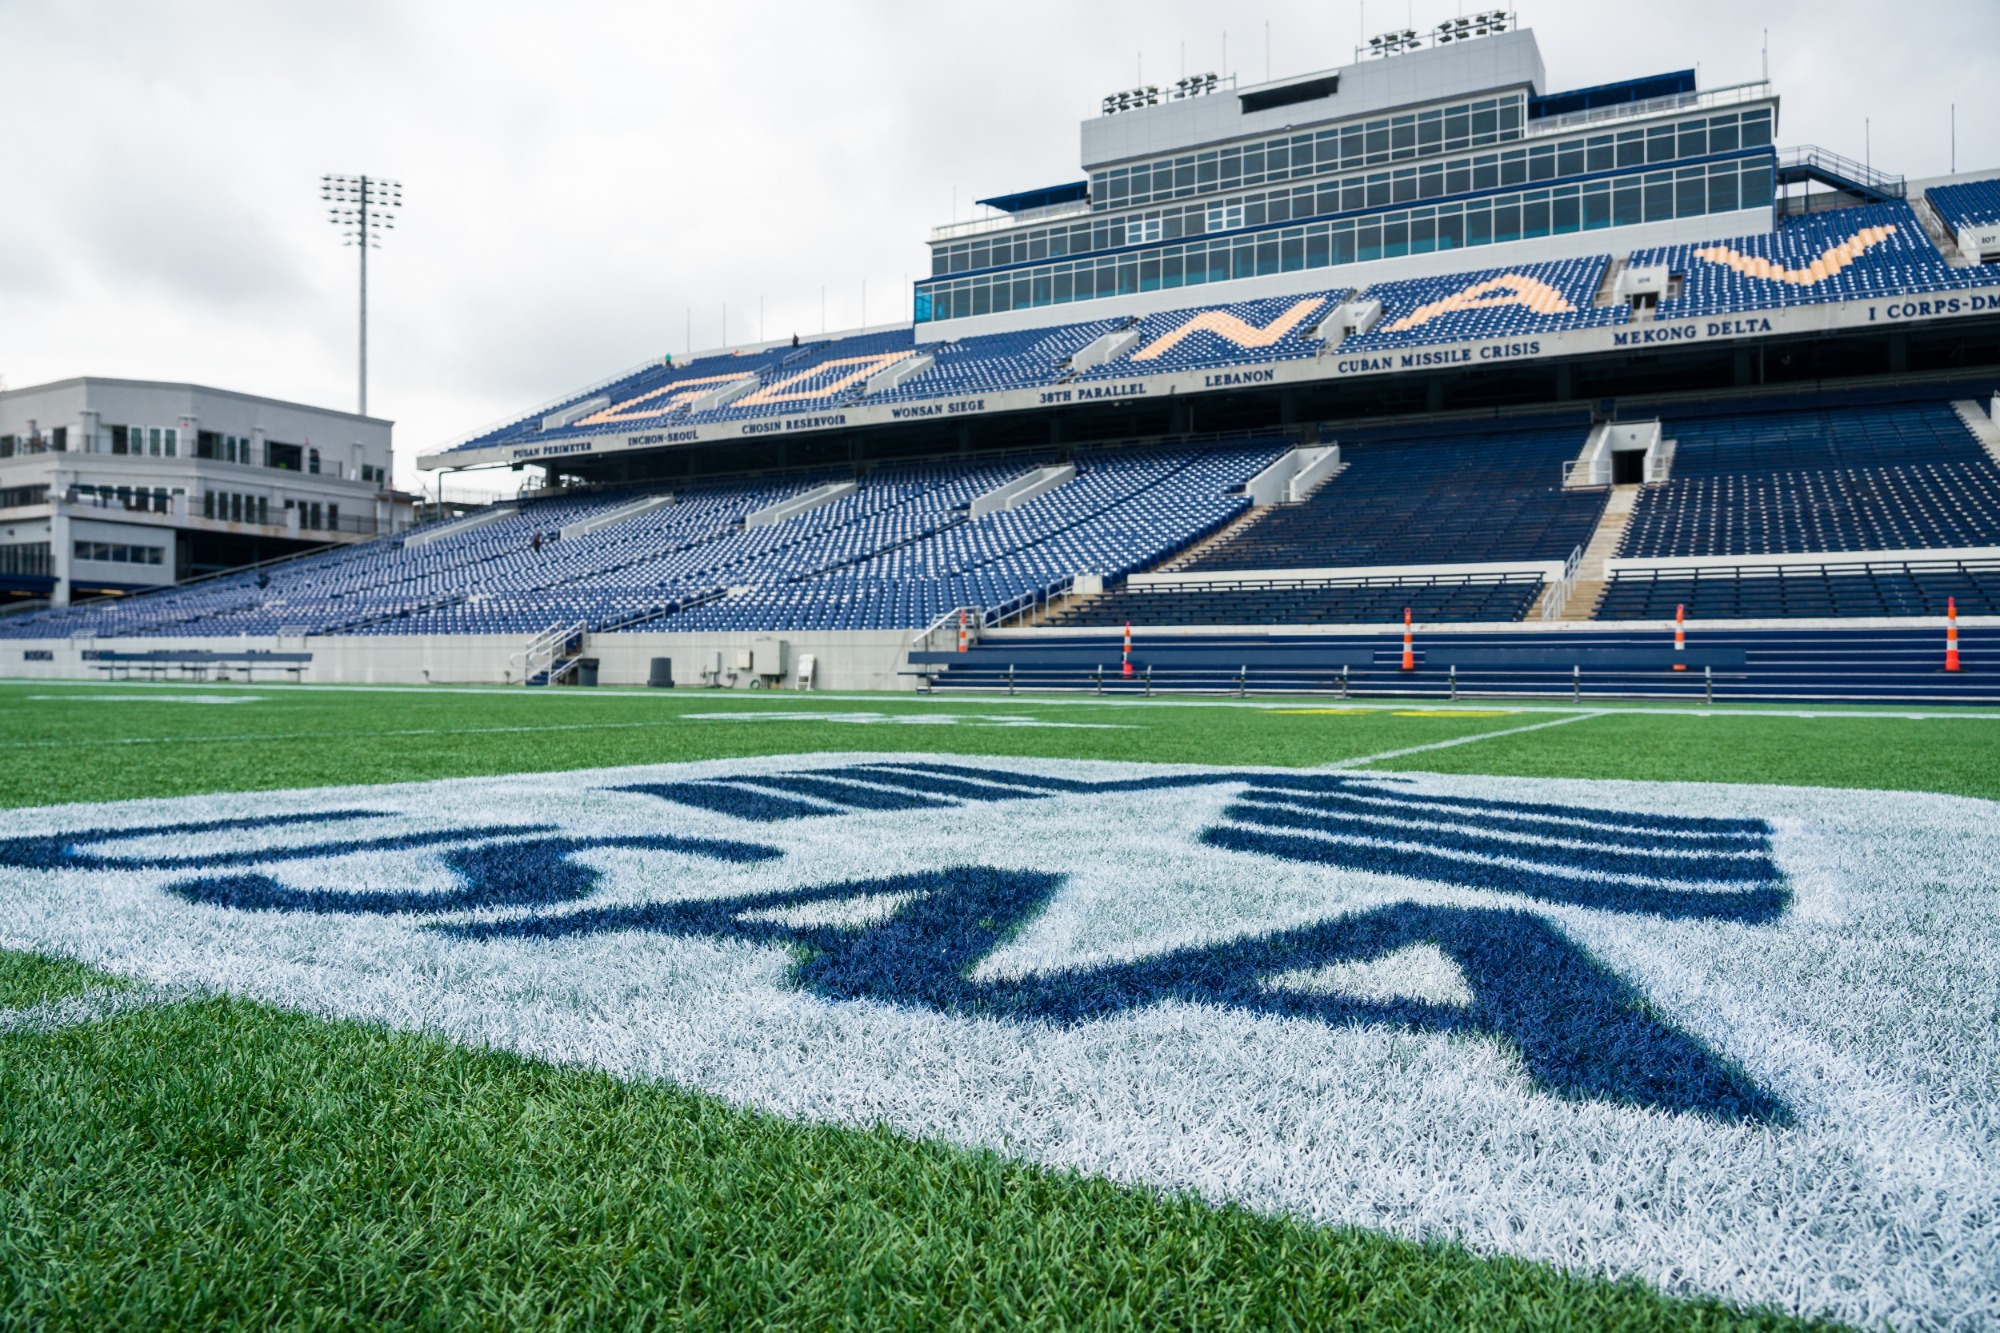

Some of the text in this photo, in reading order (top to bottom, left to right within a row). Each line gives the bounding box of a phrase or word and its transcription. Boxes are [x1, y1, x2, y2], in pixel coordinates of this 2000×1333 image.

[1868, 306, 1877, 321] I
[1613, 317, 1773, 347] MEKONG DELTA
[1337, 341, 1541, 374] CUBAN MISSILE CRISIS
[1204, 369, 1275, 388] LEBANON
[1039, 383, 1147, 404] 38TH PARALLEL
[891, 399, 986, 419] WONSAN SIEGE
[742, 414, 847, 435] CHOSIN RESERVOIR
[627, 429, 700, 447] INCHON-SEOUL
[513, 442, 592, 459] PUSAN PERIMETER
